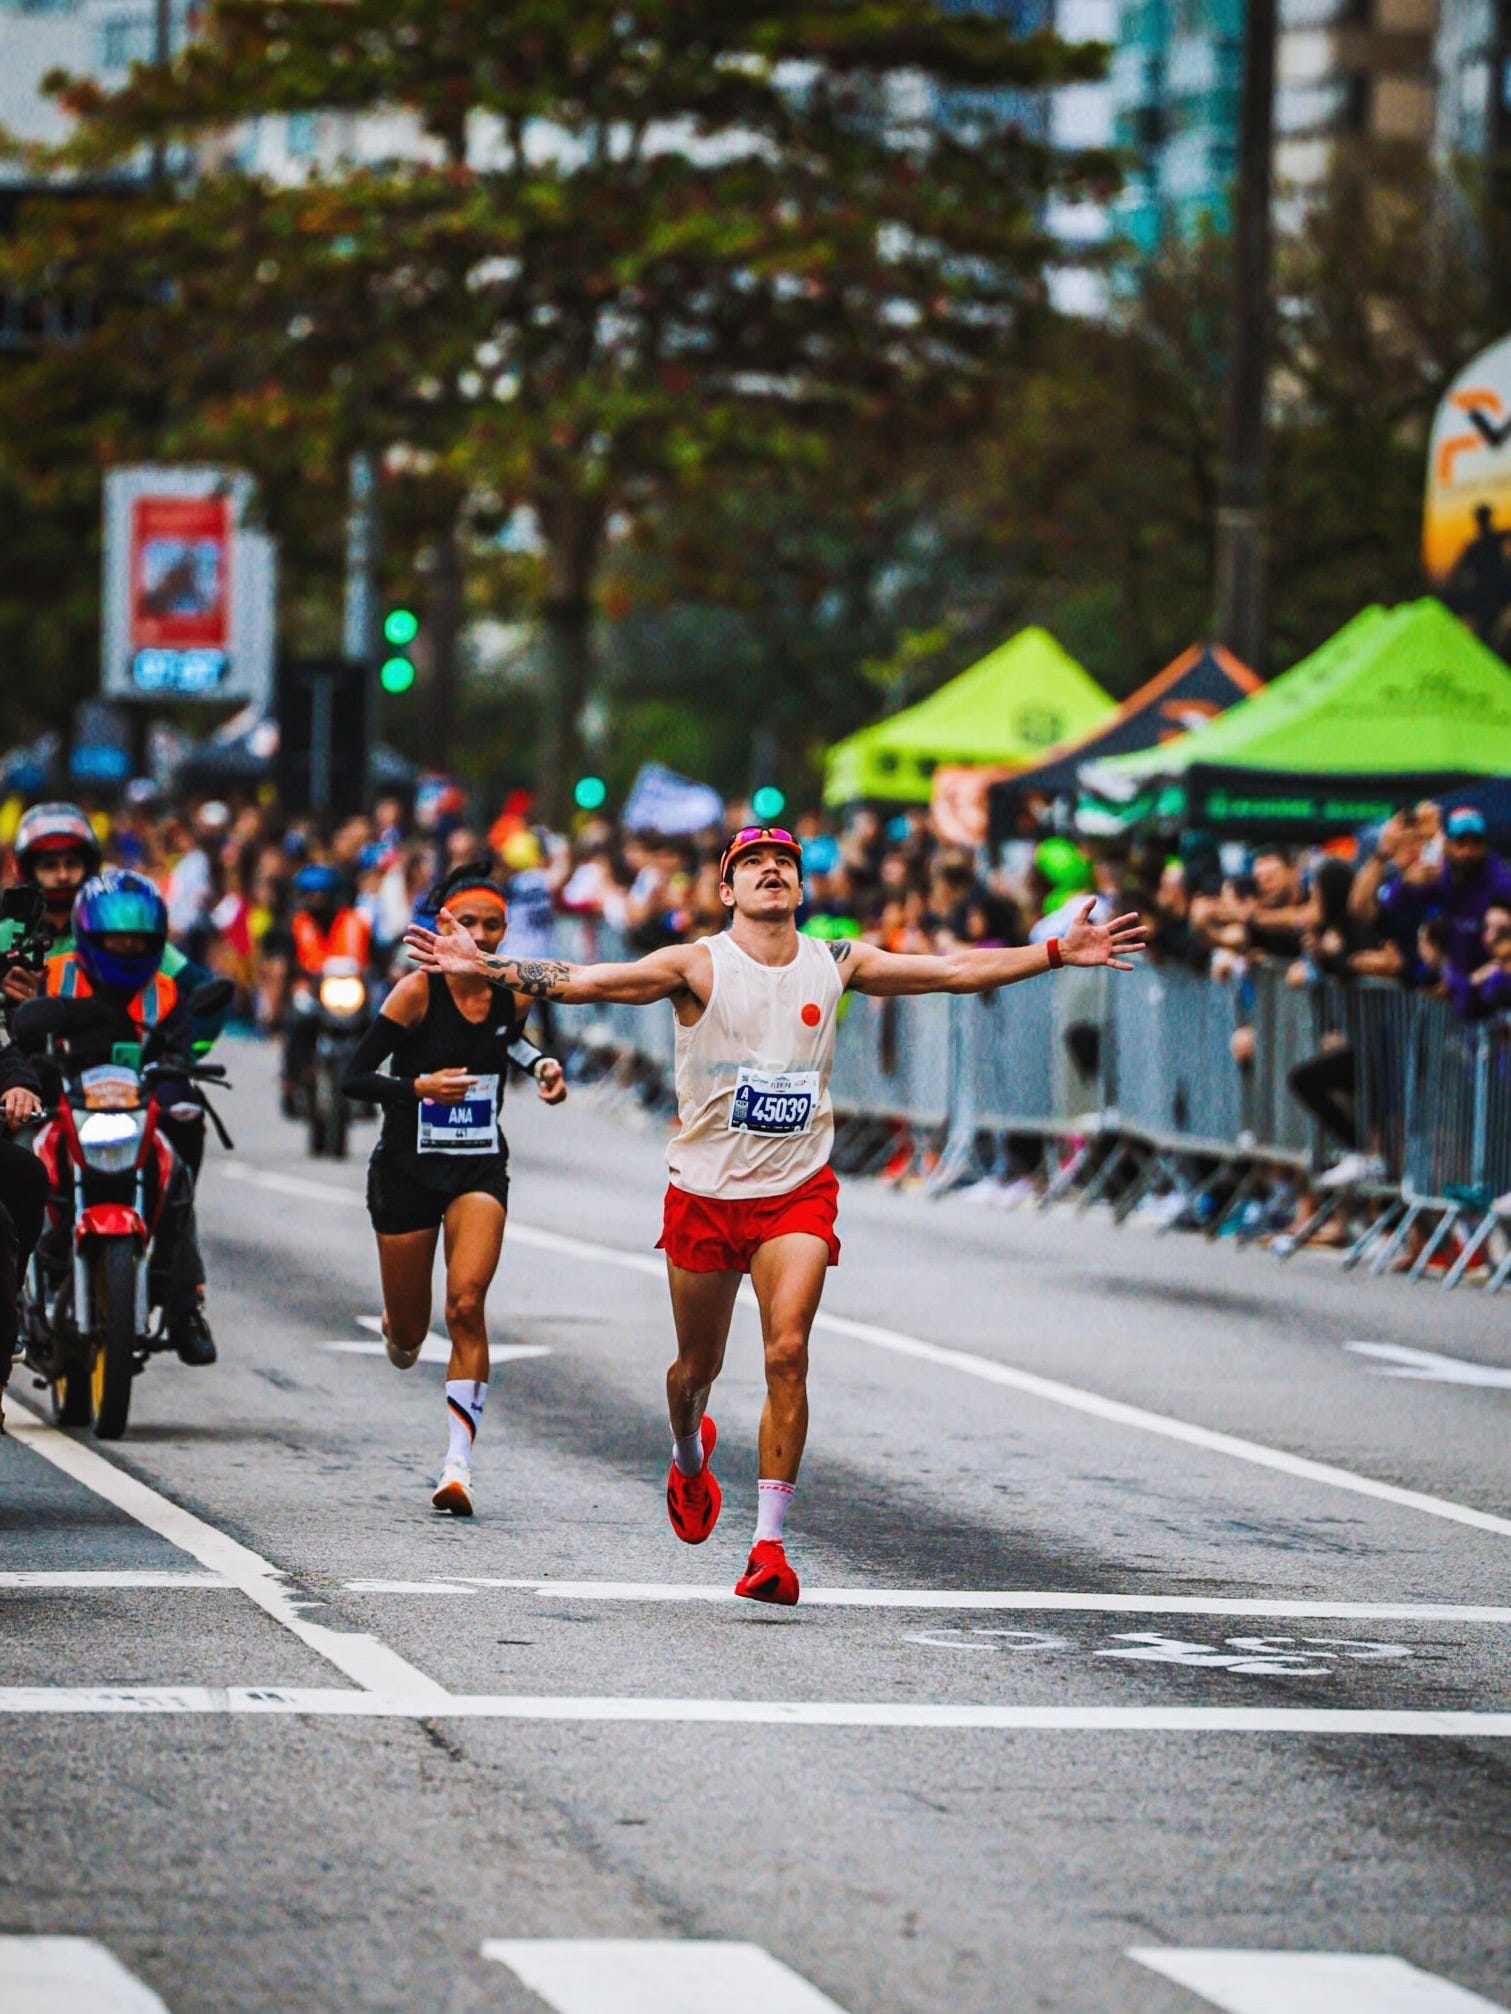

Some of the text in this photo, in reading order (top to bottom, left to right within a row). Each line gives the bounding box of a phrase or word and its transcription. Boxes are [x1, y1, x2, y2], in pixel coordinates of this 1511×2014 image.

[740, 1086, 749, 1100] A
[448, 1107, 473, 1124] ANA
[751, 1096, 808, 1122] 45039
